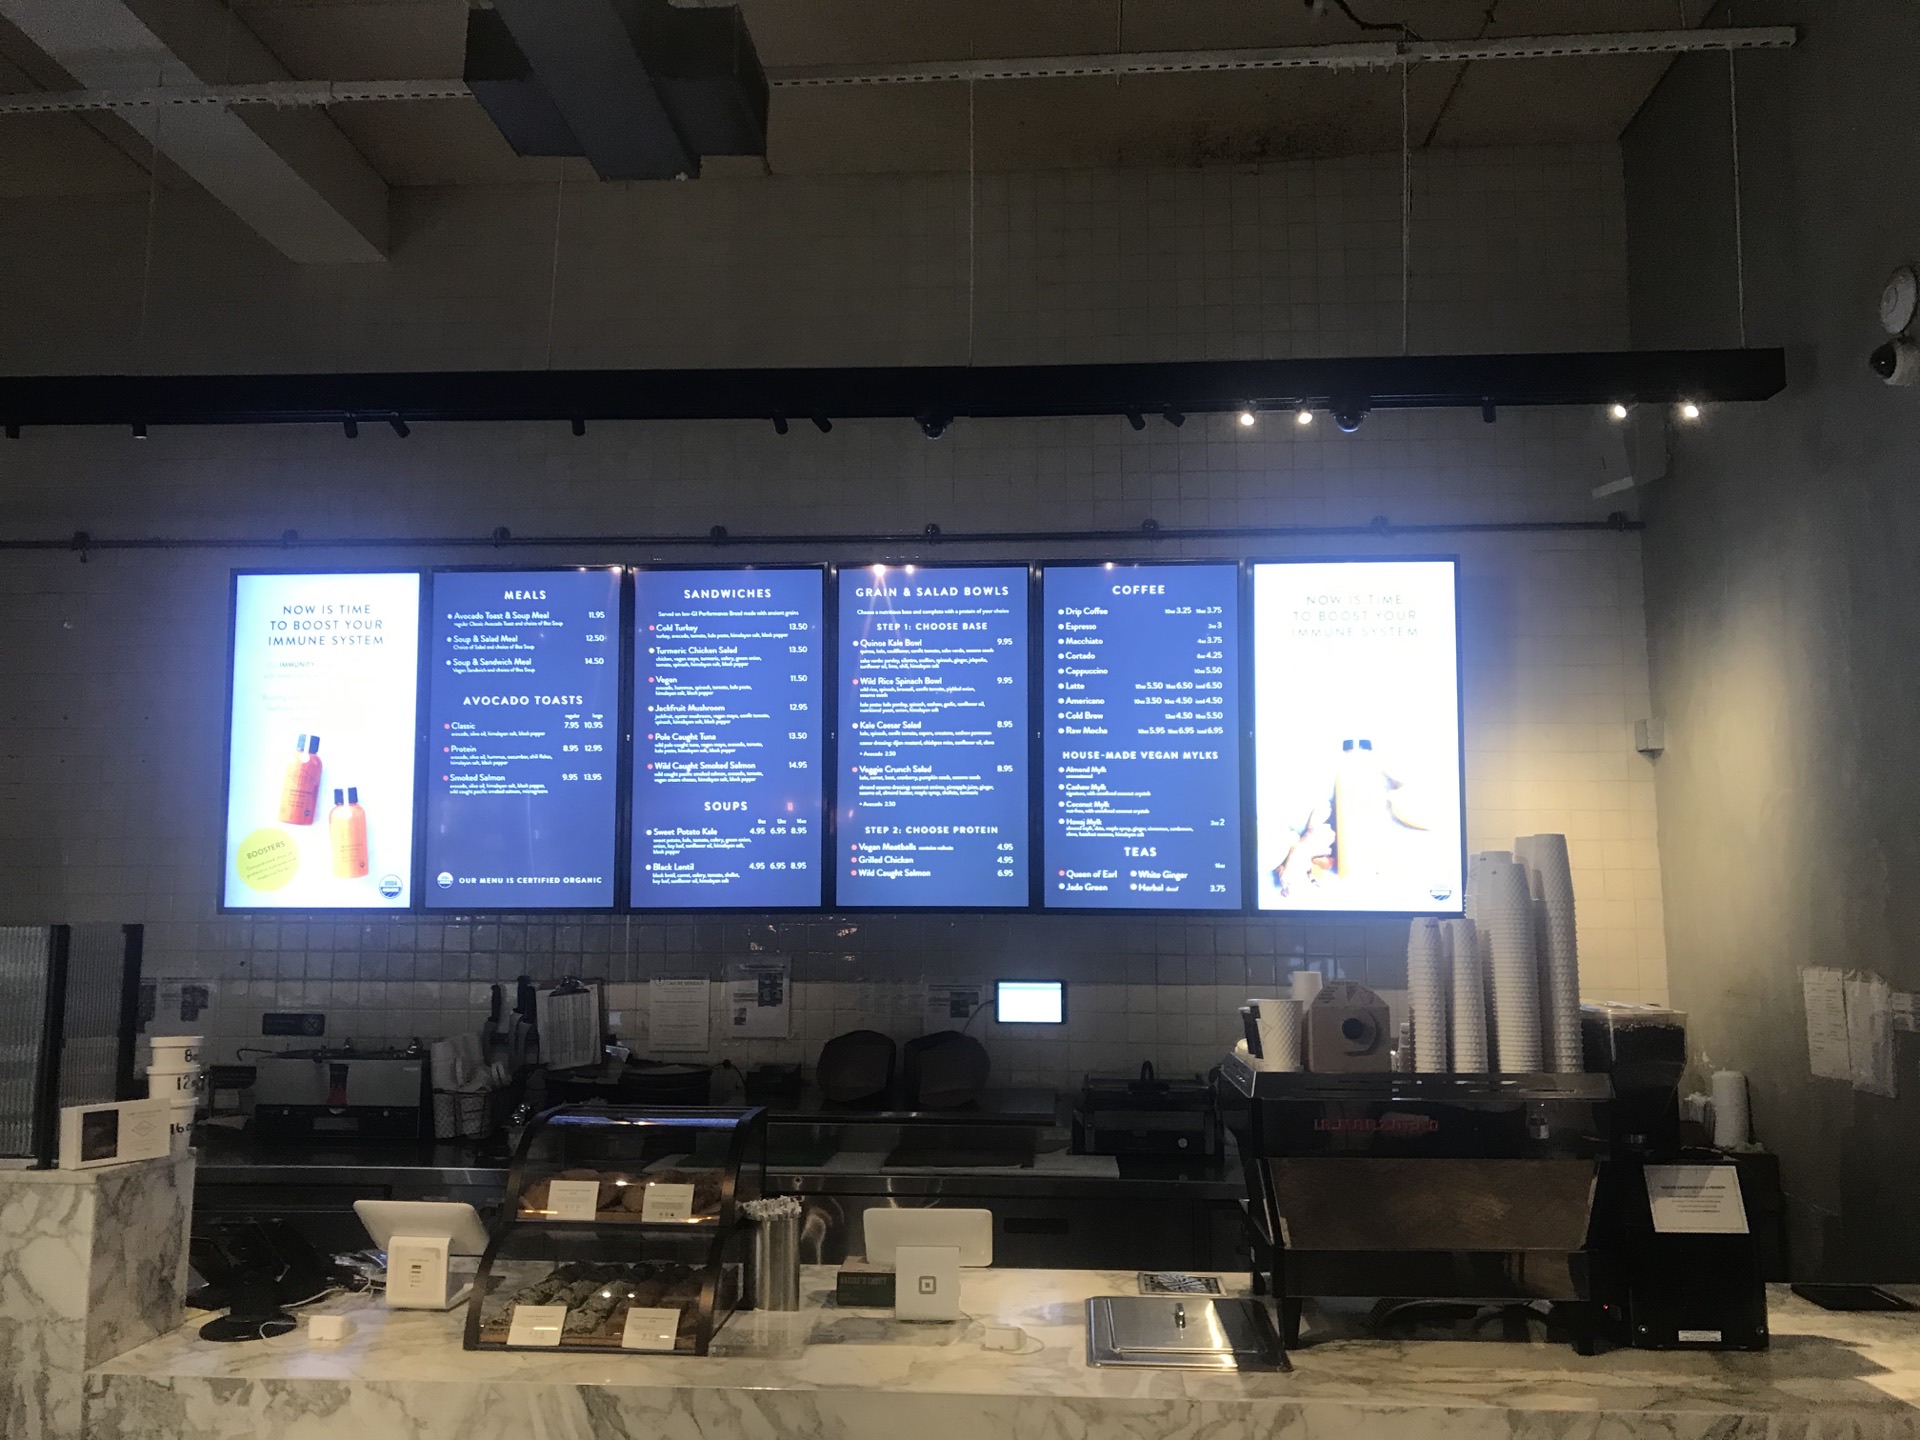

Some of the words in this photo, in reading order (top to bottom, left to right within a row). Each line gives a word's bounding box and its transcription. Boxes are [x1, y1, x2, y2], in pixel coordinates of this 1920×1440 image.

[504, 590, 546, 600] MEALS
[684, 589, 771, 599] SANDWICHES
[855, 588, 897, 597] GRAIN
[903, 588, 911, 597] &
[916, 587, 958, 596] SALAD
[964, 586, 1009, 596] BOWLS
[1112, 585, 1165, 595] COFFEE
[1306, 595, 1341, 605] NOW
[1349, 595, 1361, 605] IS
[1368, 595, 1402, 605] TIME
[283, 606, 316, 614] NOW
[322, 605, 333, 614] IS
[340, 605, 371, 614] TIME
[1066, 607, 1082, 617] Drip
[512, 611, 530, 622] Soup
[1294, 611, 1312, 621] TO
[1319, 611, 1368, 621] BOOST
[1376, 610, 1416, 620] YOUR
[270, 621, 287, 630] TO
[293, 620, 339, 630] BOOST
[345, 620, 383, 629] YOUR
[674, 624, 698, 634] Turkey
[1066, 622, 1096, 632] Espresso
[1292, 628, 1354, 637] IMMUNE
[1361, 627, 1418, 637] SYSTEM
[268, 636, 325, 646] IMMUNE
[332, 636, 384, 645] SYSTEM
[454, 635, 471, 645] Soup
[860, 639, 886, 648] Quinoa
[452, 658, 471, 669] Soup
[1066, 667, 1108, 677] Cappuccino
[655, 676, 677, 686] Vegan
[895, 677, 923, 687] Spinach
[463, 696, 529, 705] AVOCADO
[534, 696, 582, 705] TOASTS
[876, 721, 901, 729] Caesar
[672, 733, 698, 743] Caught
[1063, 751, 1136, 759] HOUSE-MADE
[1141, 751, 1178, 759] VEGAN
[1183, 751, 1218, 759] MYLKS
[672, 762, 698, 772] Caught
[859, 766, 883, 776] Veggie
[704, 801, 747, 811] SOUPS
[246, 841, 286, 860] BOOSTERS
[858, 843, 880, 853] Vegan
[1124, 847, 1156, 857] TEAS
[876, 869, 903, 879] Caught
